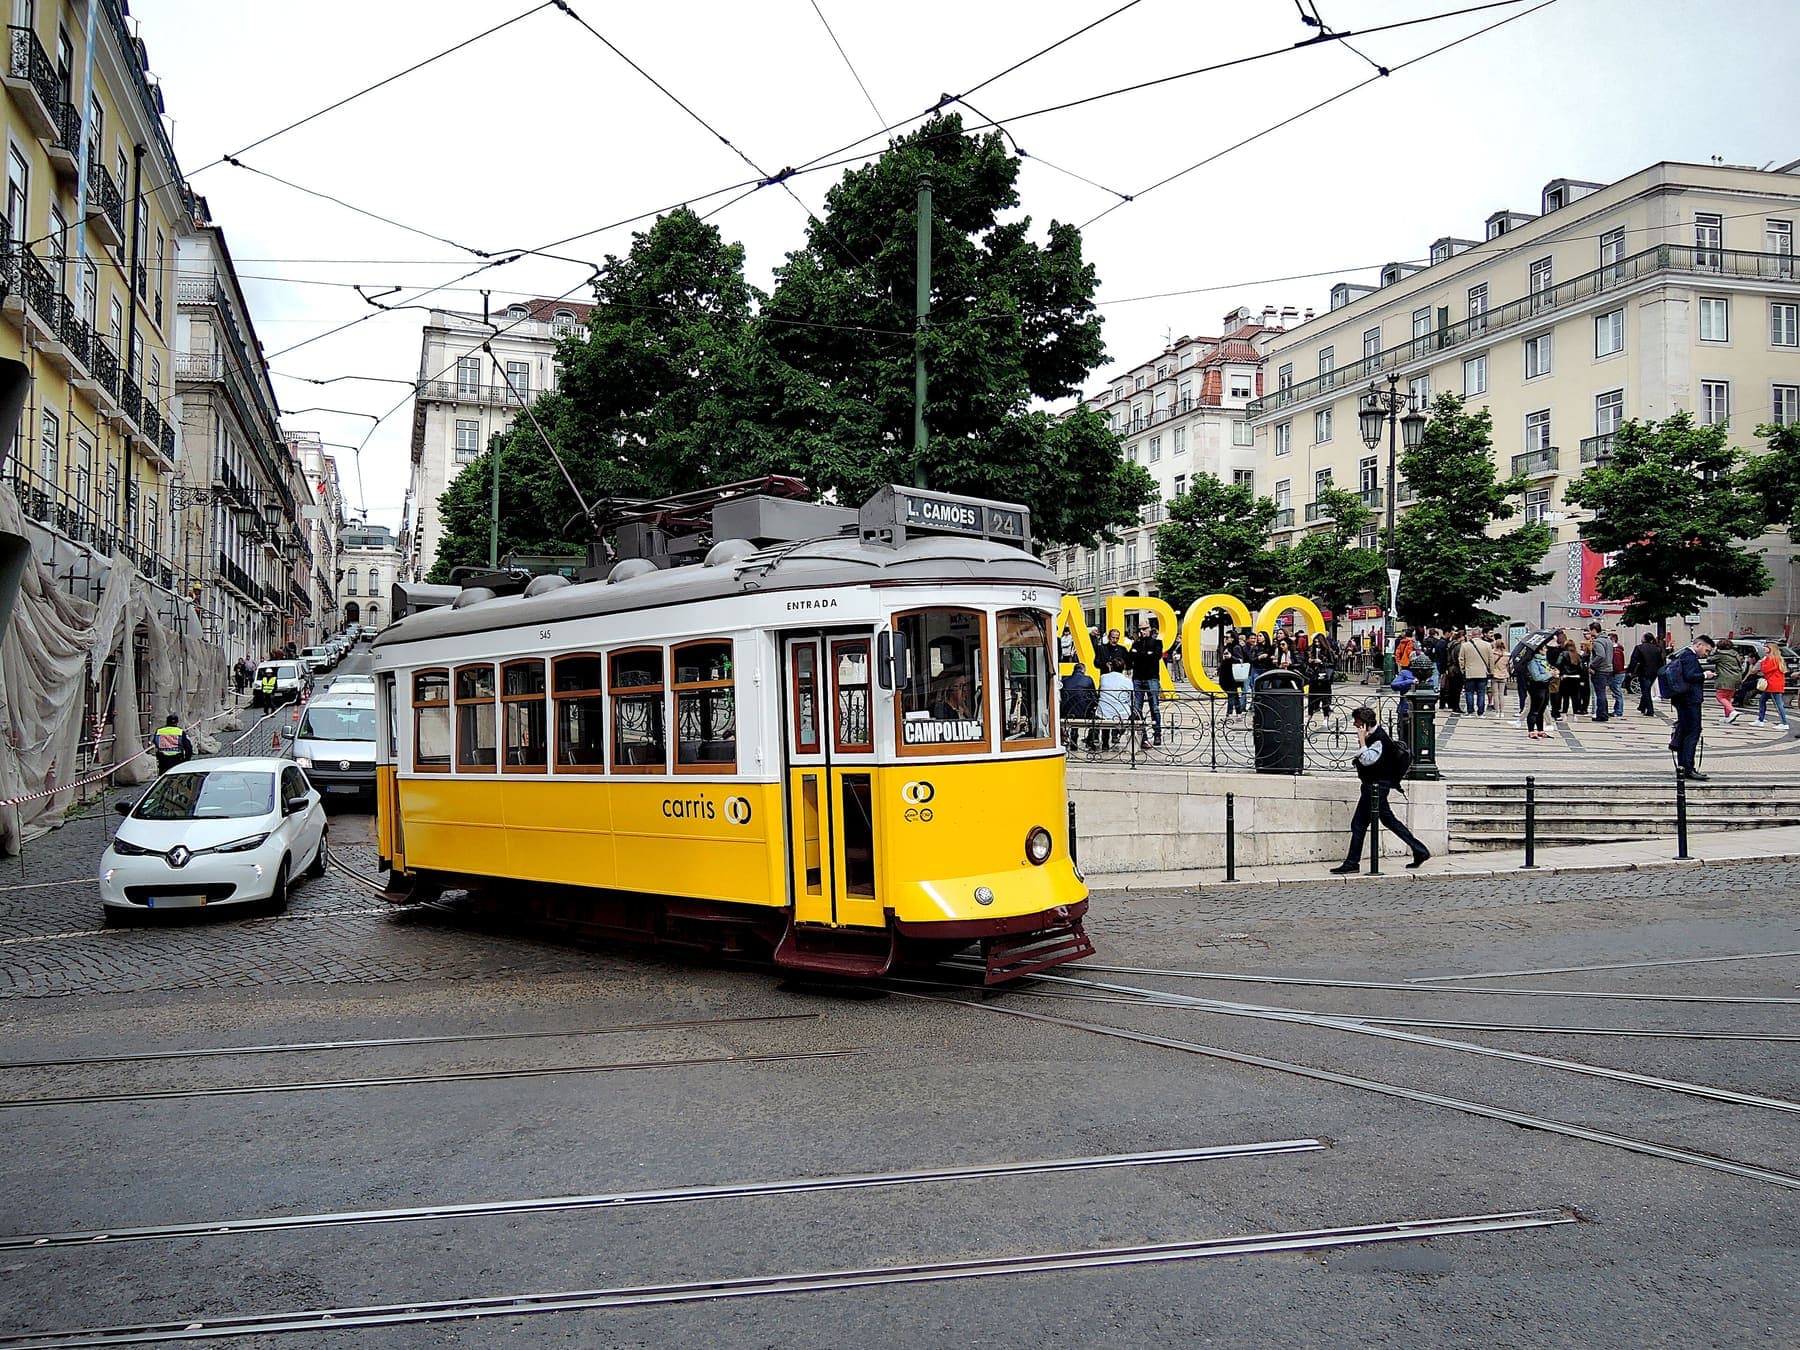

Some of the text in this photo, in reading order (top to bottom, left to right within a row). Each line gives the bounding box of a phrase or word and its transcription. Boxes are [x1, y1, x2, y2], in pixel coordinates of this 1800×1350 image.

[908, 499, 919, 517] L.
[993, 513, 1014, 535] 24
[1021, 590, 1037, 601] 545
[786, 598, 837, 611] ENTRADA
[539, 629, 551, 640] 545
[662, 793, 715, 819] carris
